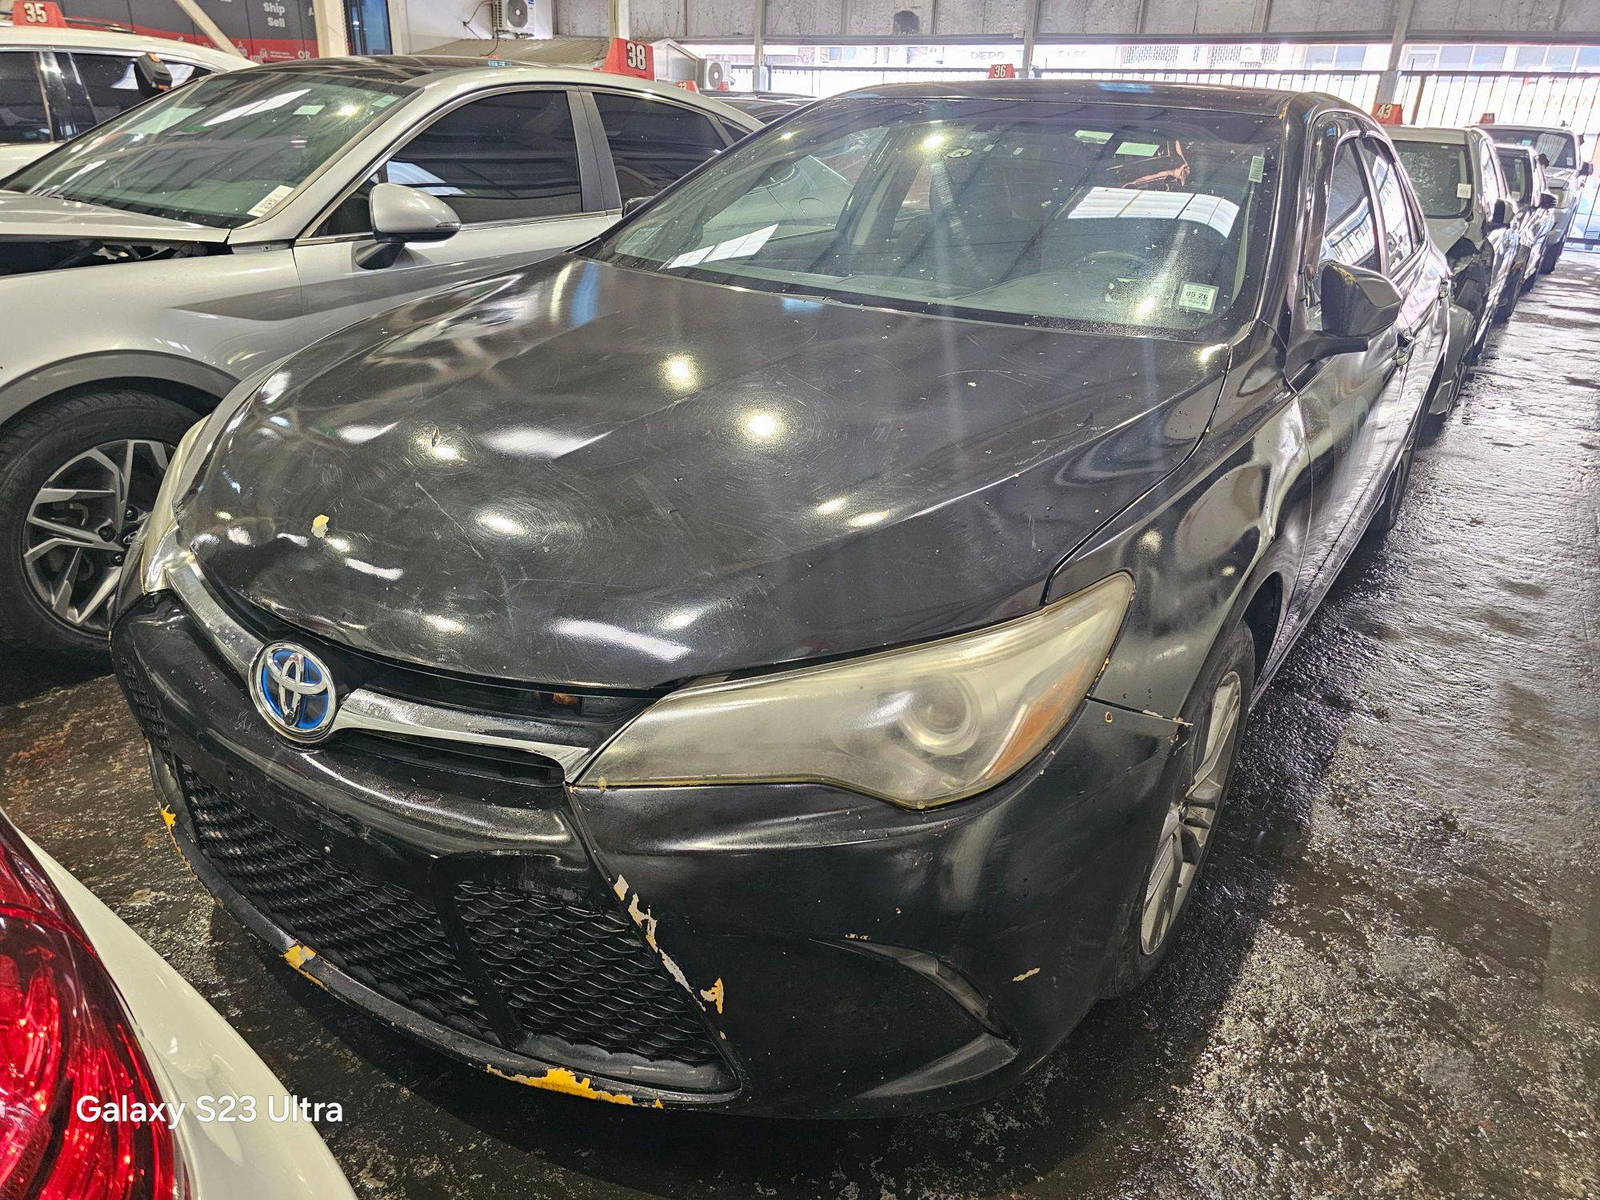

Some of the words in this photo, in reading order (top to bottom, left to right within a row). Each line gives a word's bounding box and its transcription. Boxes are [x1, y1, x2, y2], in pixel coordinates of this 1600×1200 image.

[23, 2, 48, 23] 35
[263, 2, 286, 16] Ship
[267, 17, 286, 28] Sell
[626, 42, 646, 70] 38
[993, 64, 1007, 78] 36
[1376, 104, 1393, 119] 43
